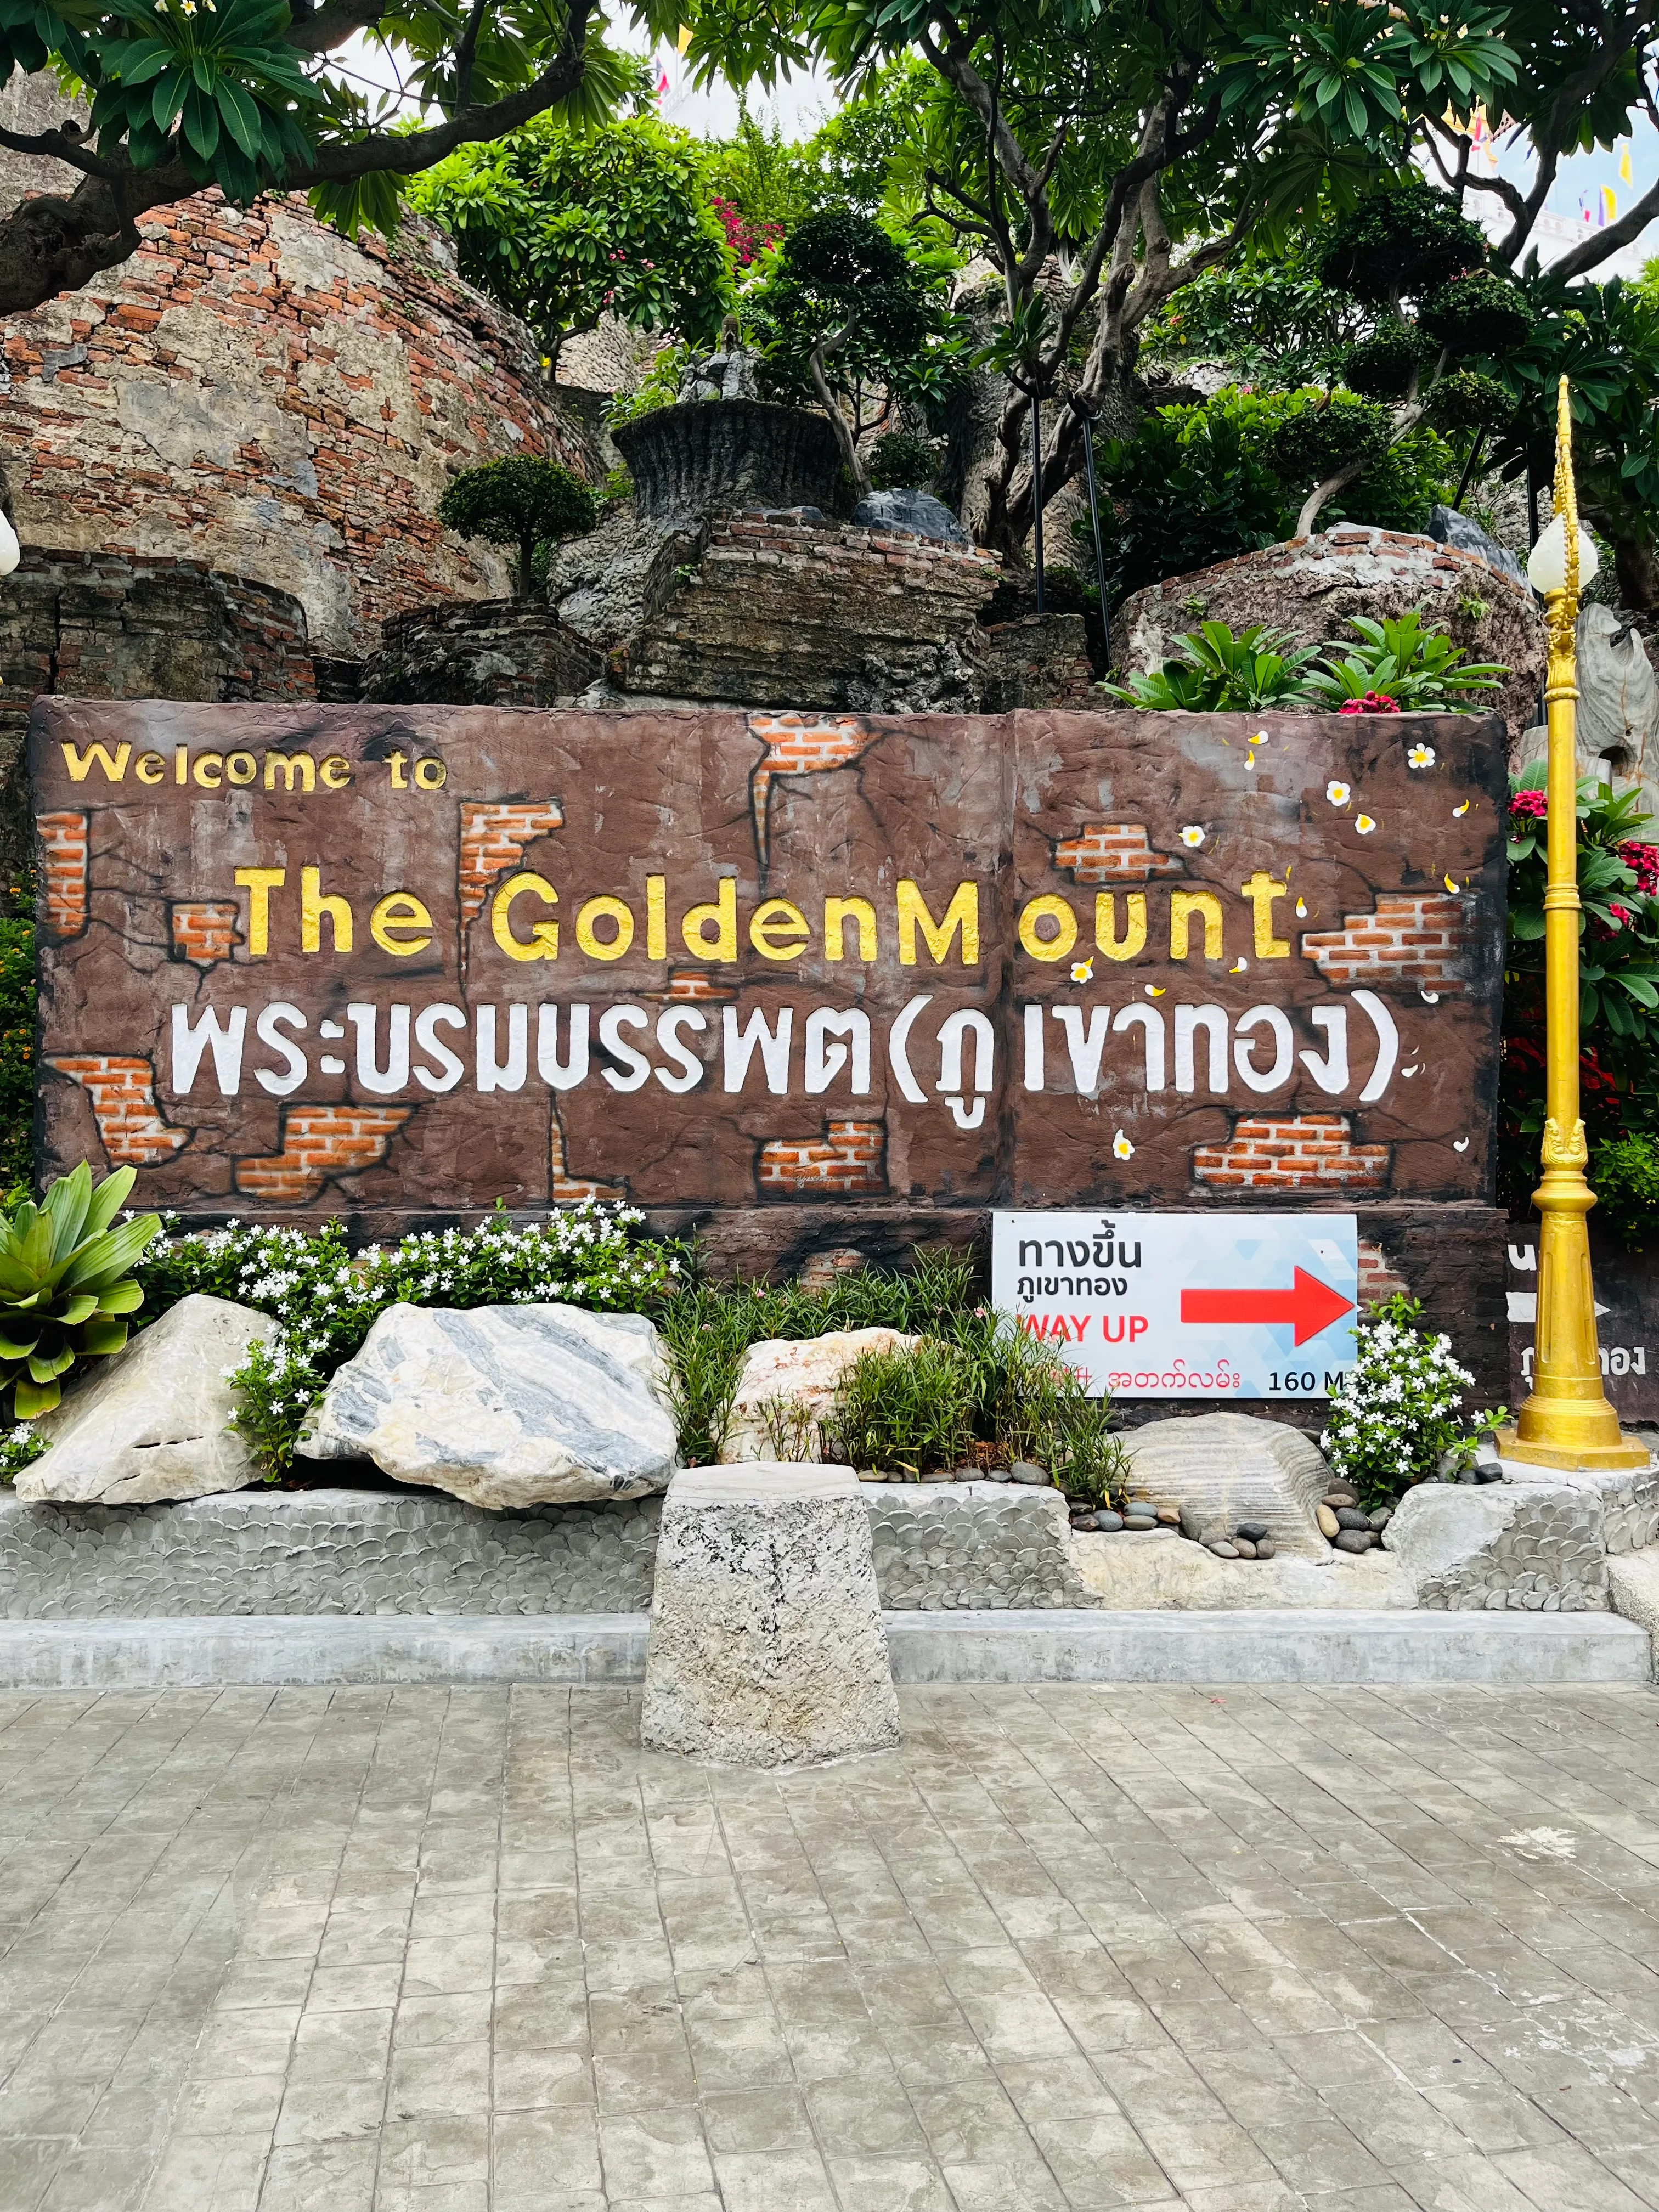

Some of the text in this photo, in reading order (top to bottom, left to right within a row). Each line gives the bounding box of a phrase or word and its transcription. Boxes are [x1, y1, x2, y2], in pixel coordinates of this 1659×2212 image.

[61, 740, 447, 792] Welcome to
[235, 866, 433, 956] The
[1019, 1219, 1142, 1268] ทางขึ้น
[1017, 1276, 1128, 1303] ภูเขาทอง
[1015, 1314, 1149, 1343] WAY UP
[1269, 1372, 1316, 1391] 160
